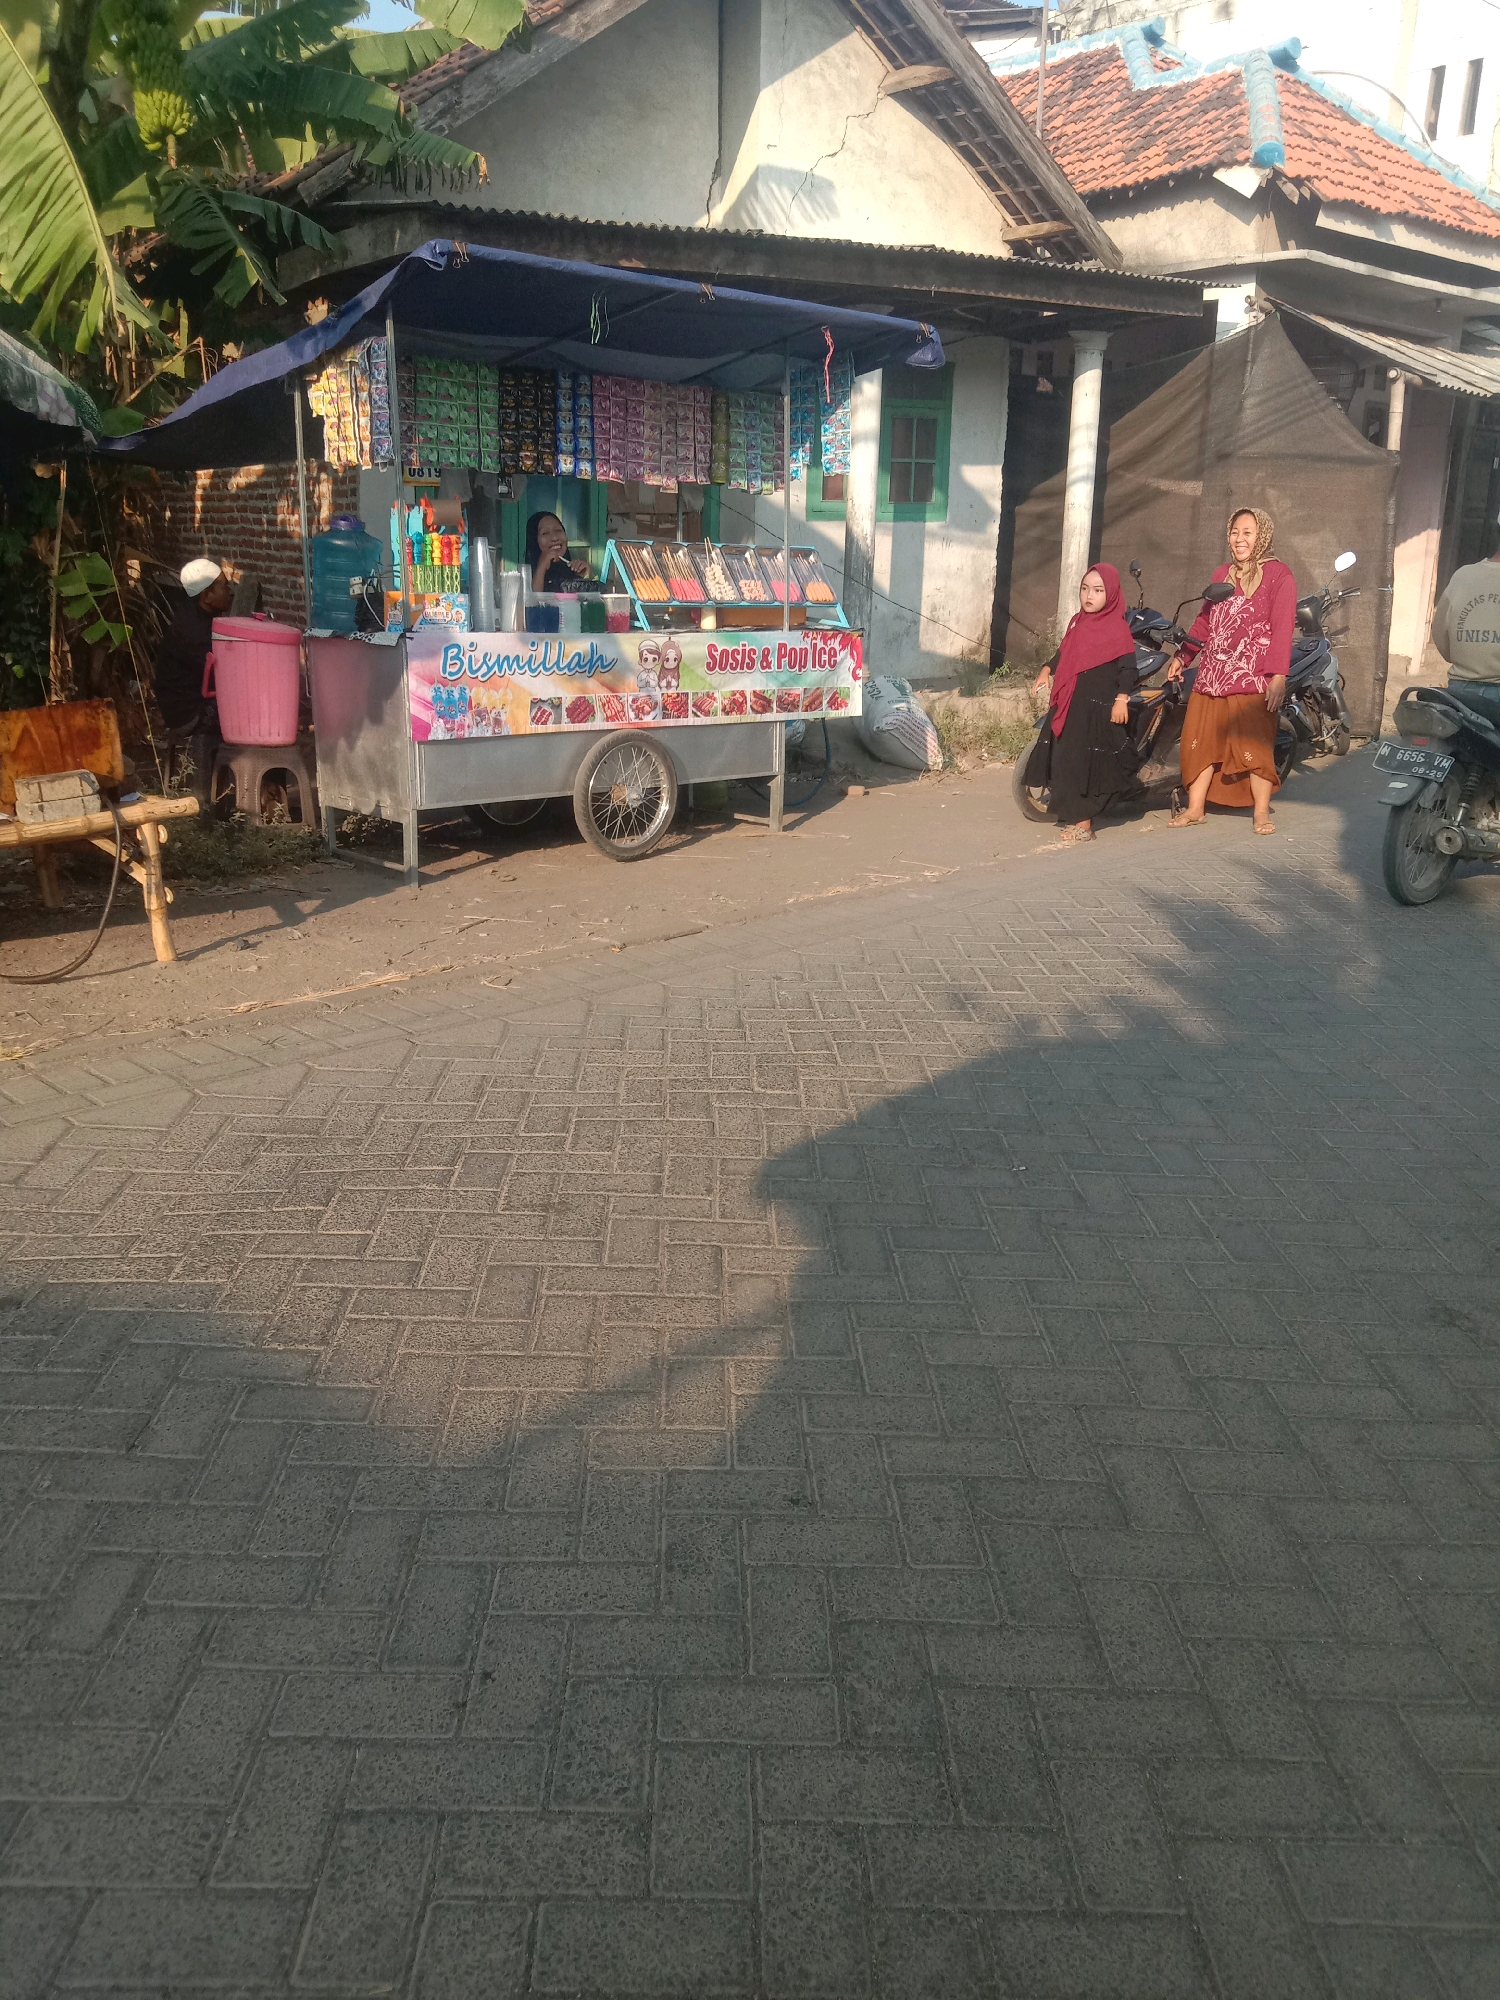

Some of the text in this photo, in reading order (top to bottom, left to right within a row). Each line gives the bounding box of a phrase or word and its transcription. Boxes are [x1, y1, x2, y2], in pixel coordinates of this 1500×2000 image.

[1457, 594, 1485, 629] FAKULTAS
[440, 640, 617, 680] Bismillah
[705, 642, 838, 673] Sosis & Pop Ice
[1396, 750, 1426, 762] 6656
[1433, 756, 1451, 769] VM
